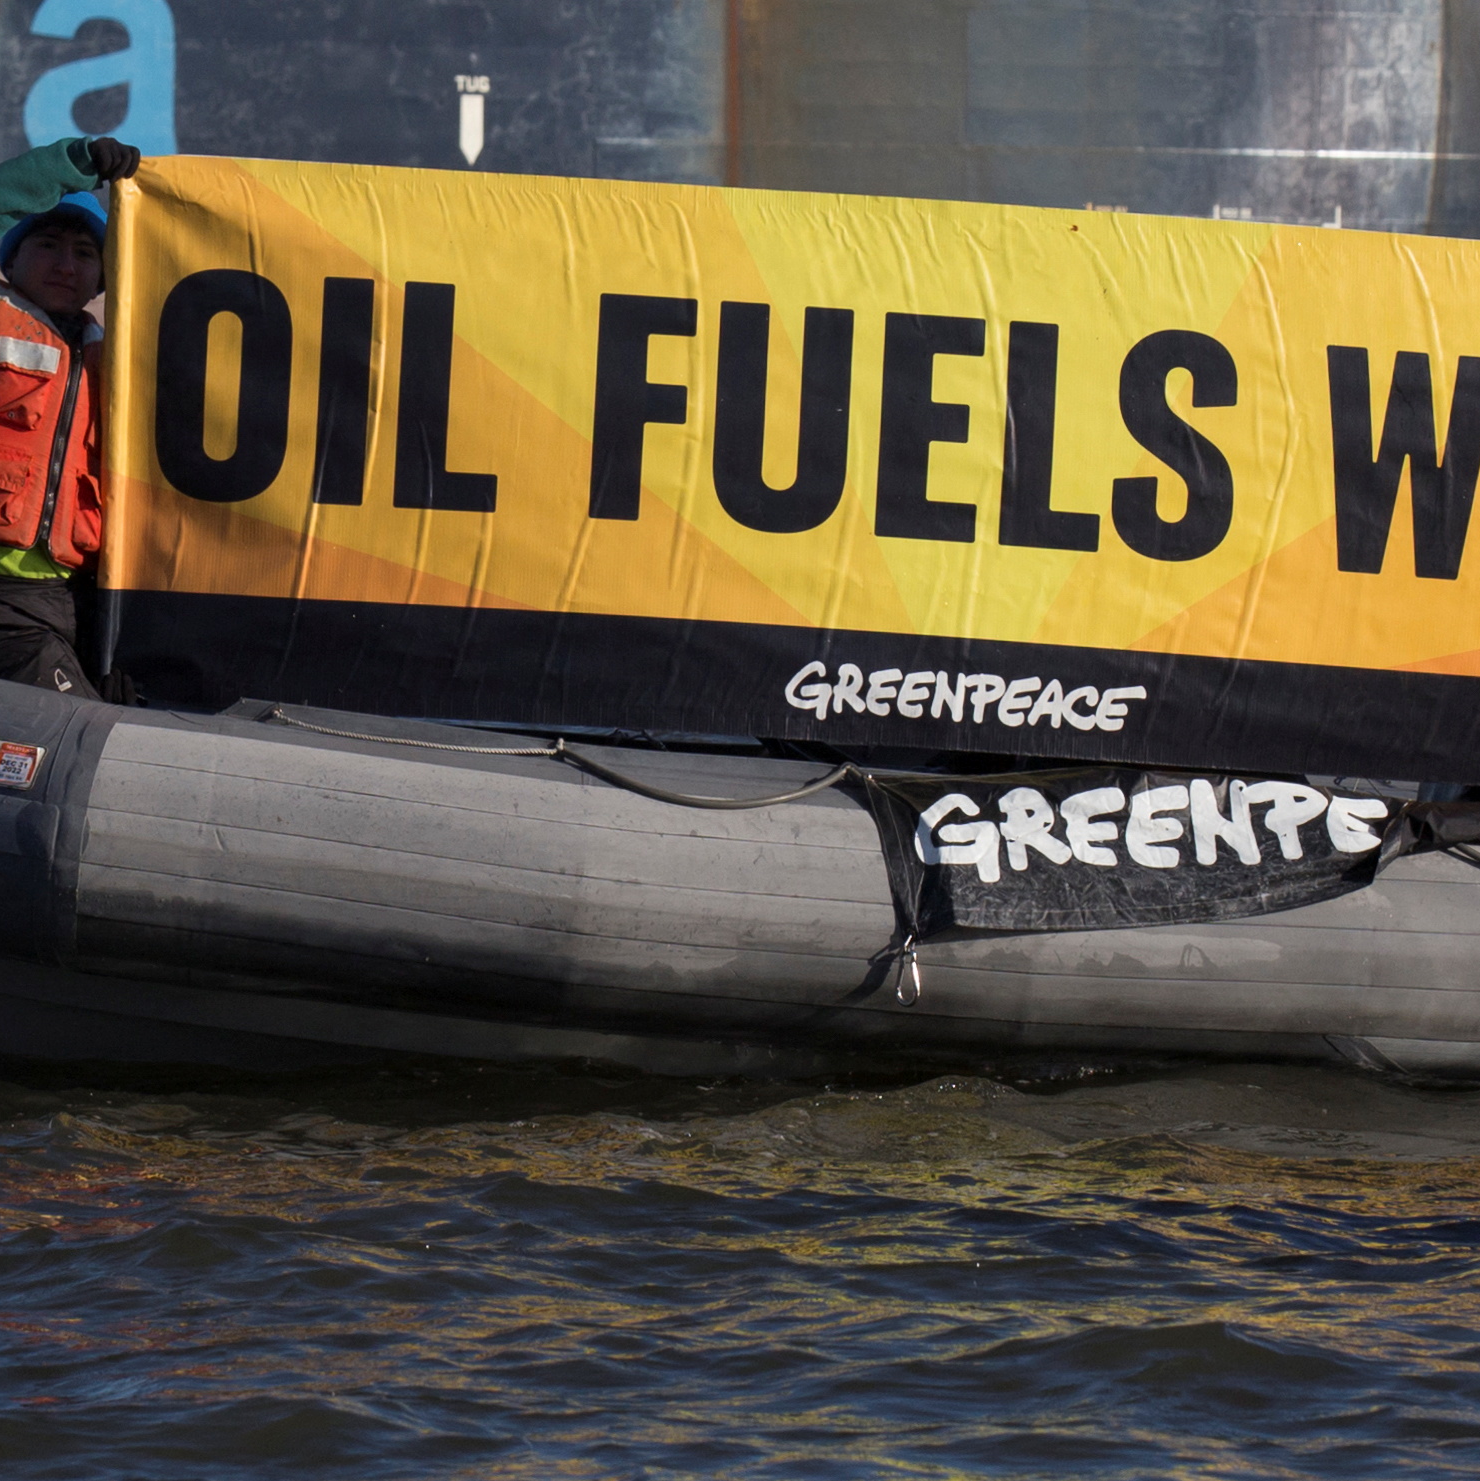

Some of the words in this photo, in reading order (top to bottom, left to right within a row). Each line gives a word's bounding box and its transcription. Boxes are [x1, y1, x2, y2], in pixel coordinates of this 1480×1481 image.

[454, 74, 491, 93] TUG
[155, 268, 499, 514] OIL
[588, 292, 1238, 563] FUELS
[784, 660, 1147, 732] GREENPEACE
[0, 759, 17, 767] DEC
[18, 761, 28, 769] 31
[915, 779, 1388, 884] GREENPE
